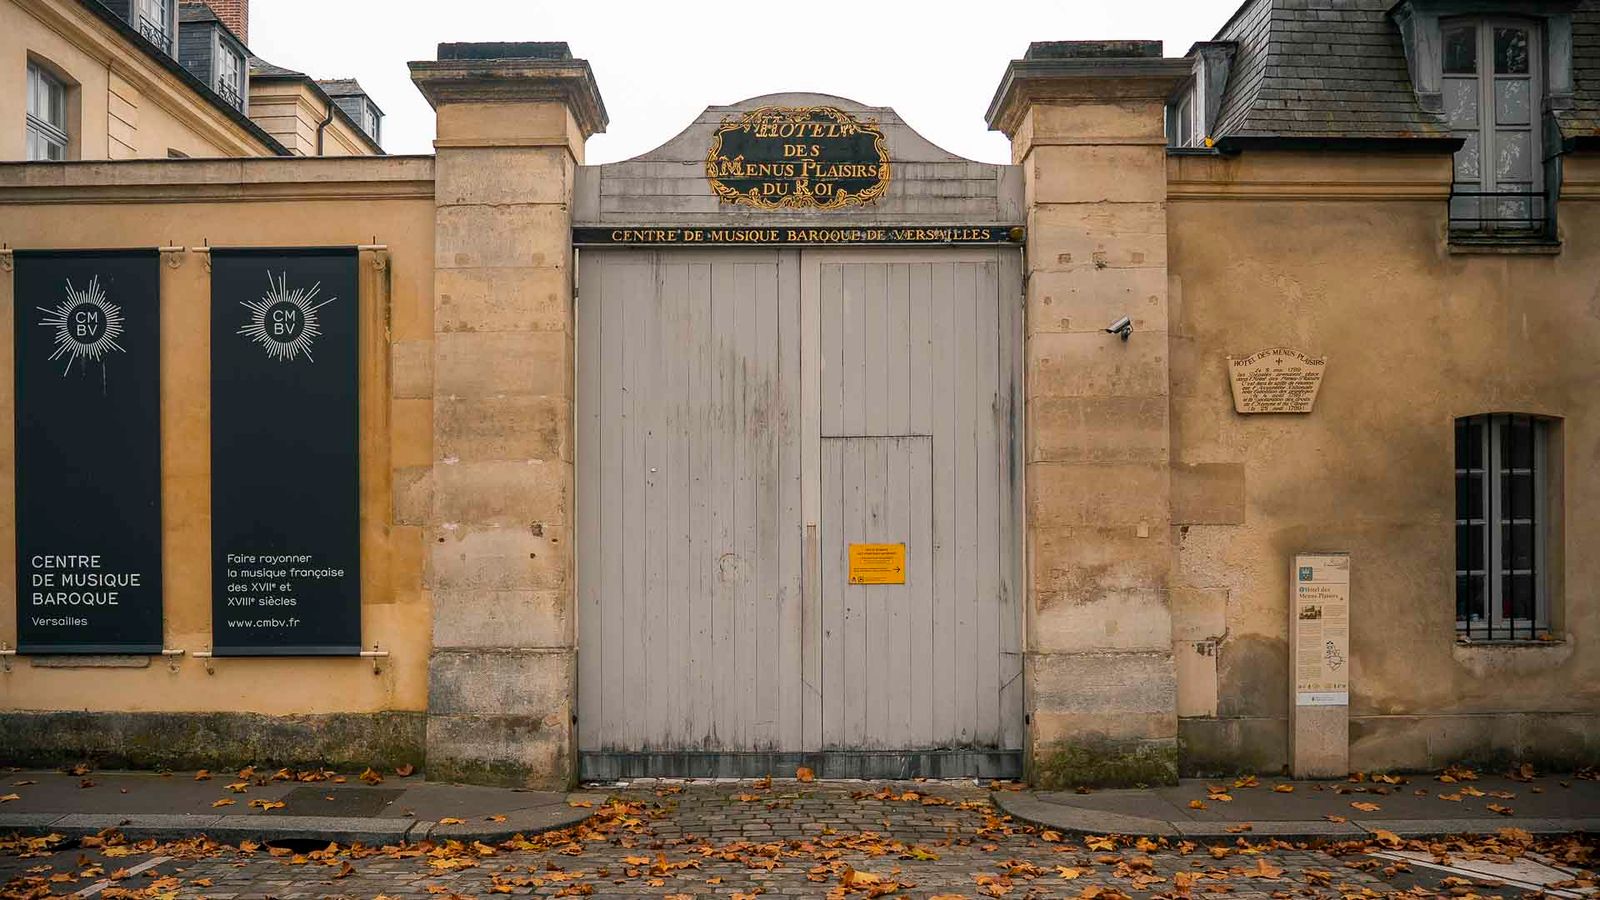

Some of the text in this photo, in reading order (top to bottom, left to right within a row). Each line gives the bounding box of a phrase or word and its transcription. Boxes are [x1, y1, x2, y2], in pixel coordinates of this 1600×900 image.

[784, 144, 820, 157] DES
[720, 154, 878, 178] MENUS PLAISIRS
[763, 179, 834, 197] DU ROI
[611, 229, 991, 243] CENTRE DE MUSIQUE BAROQUE DE VERSAILLES
[75, 311, 98, 324] CM
[272, 309, 296, 322] CM
[76, 324, 98, 337] BV
[273, 322, 296, 335] BV
[31, 555, 101, 569] CENTRE
[227, 553, 313, 566] Faire rayonner
[227, 567, 345, 580] la musique française
[32, 573, 141, 588] DE MUSIQUE
[227, 582, 248, 593] des
[279, 582, 292, 592] et
[32, 591, 119, 607] BAROQUE
[258, 595, 297, 606] siècles
[31, 616, 88, 626] Versailles
[227, 617, 301, 628] www.cmbv.fr
